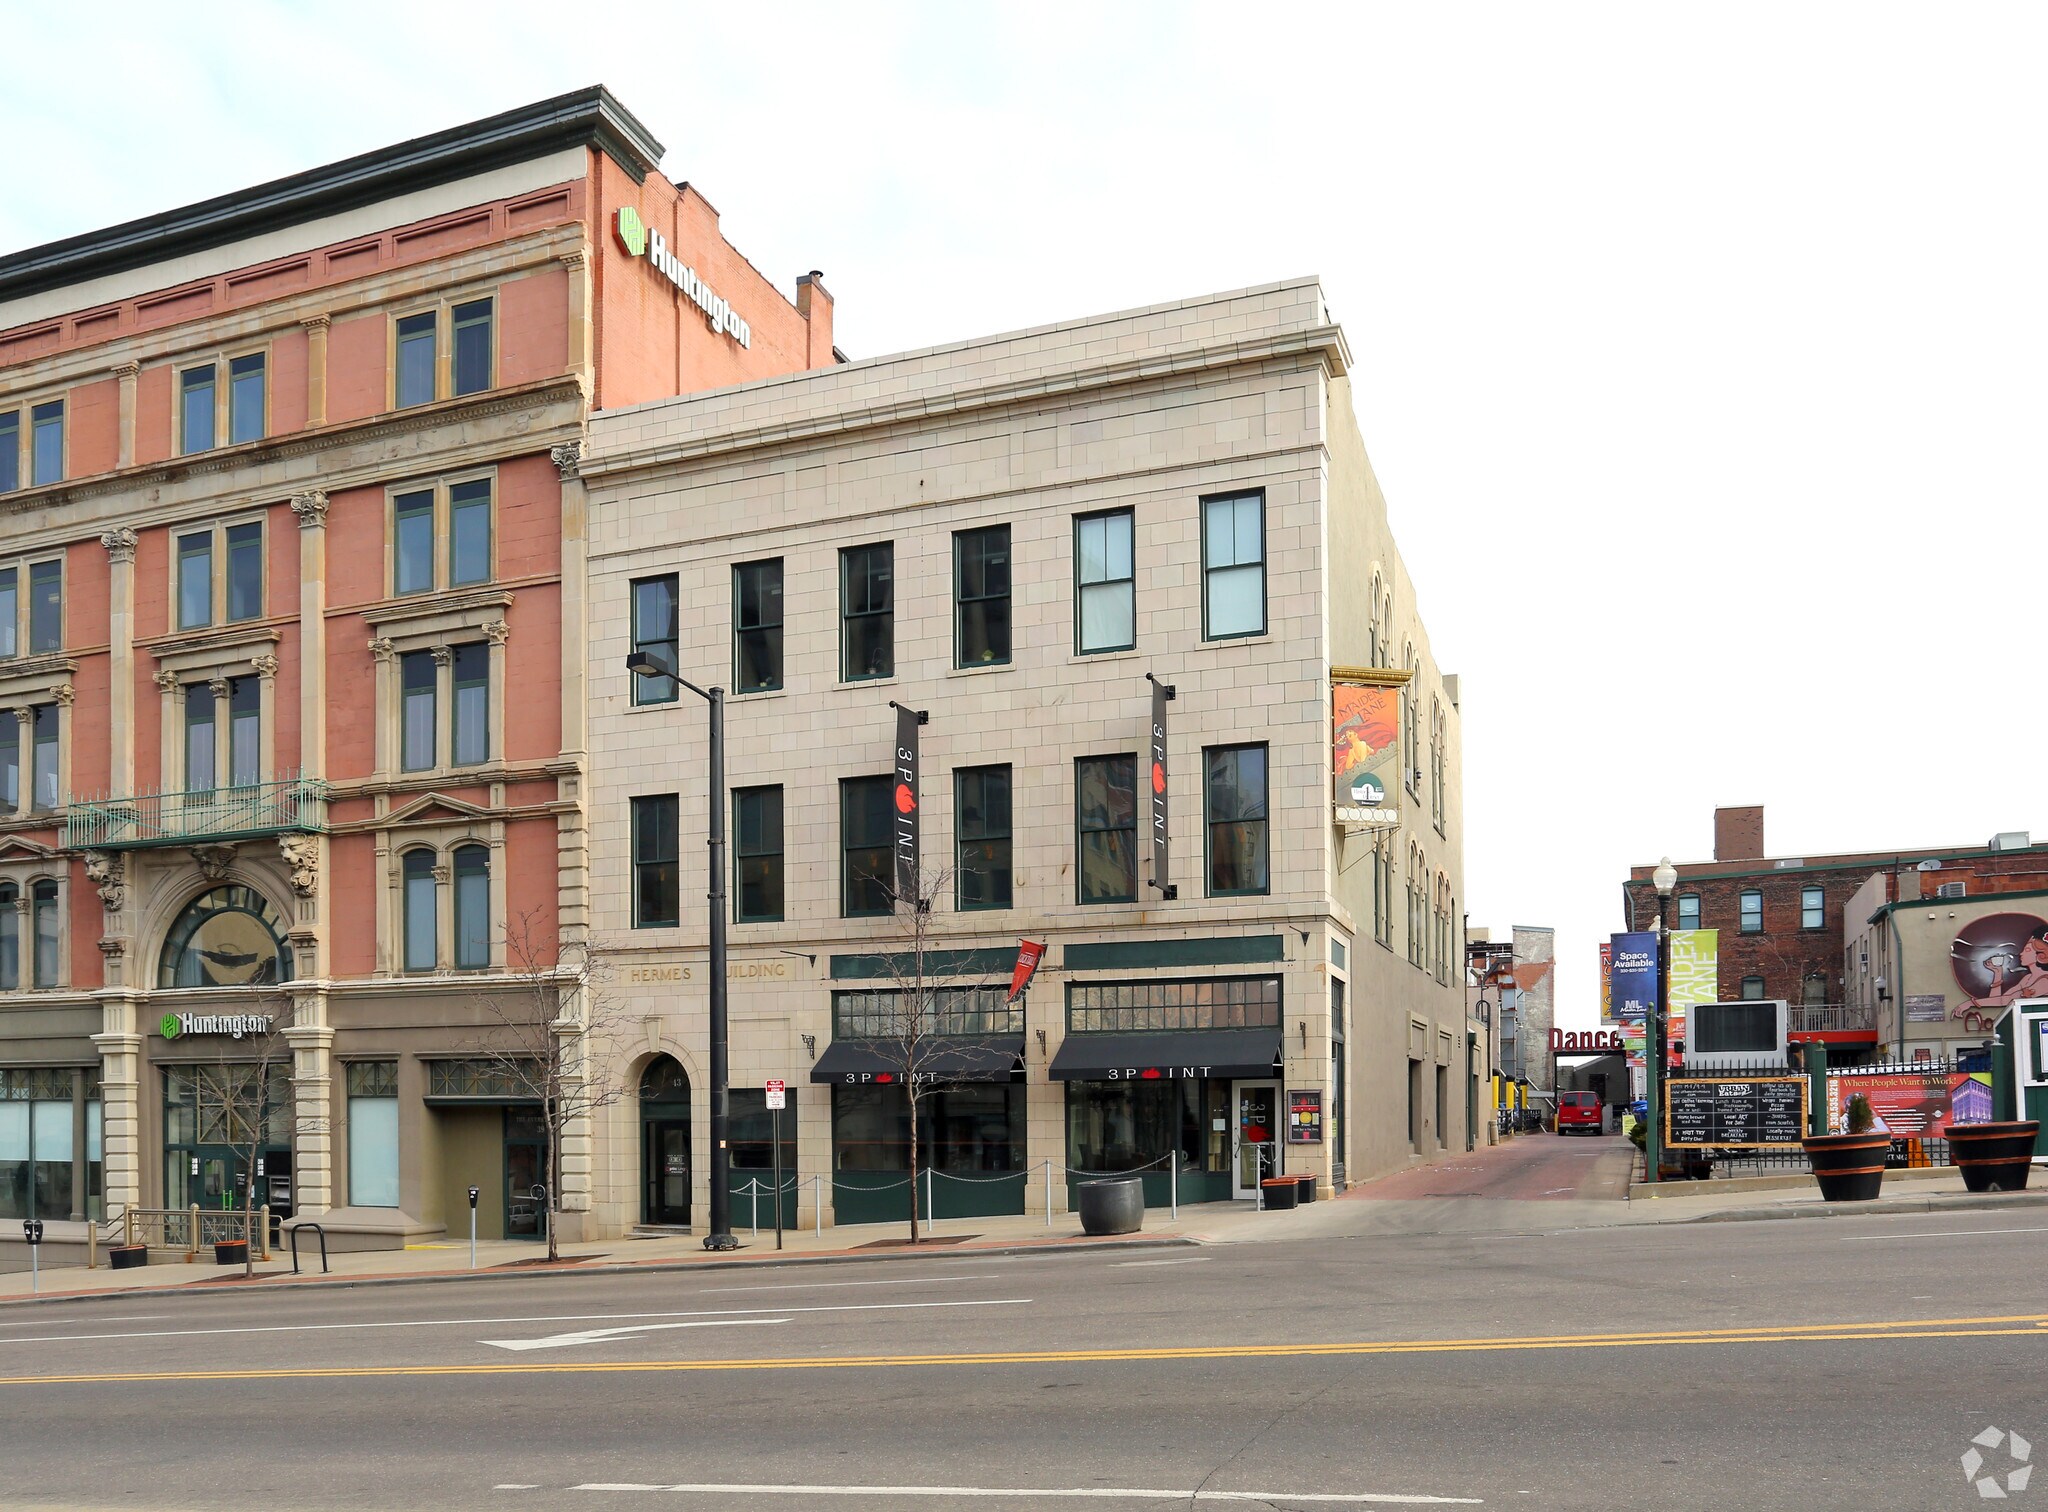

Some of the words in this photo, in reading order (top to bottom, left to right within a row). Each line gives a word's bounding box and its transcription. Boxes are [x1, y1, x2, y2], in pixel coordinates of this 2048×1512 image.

[650, 227, 750, 350] Huntington
[1338, 690, 1380, 720] MAIDEN
[1357, 697, 1387, 723] LANE
[1613, 959, 1654, 969] Available
[1619, 952, 1649, 962] Space
[631, 967, 691, 982] HERMES
[726, 963, 785, 978] UILDING
[1694, 951, 1717, 1003] ANE
[182, 1012, 267, 1039] Huntington
[1548, 1027, 1620, 1052] Dance
[1844, 1079, 1869, 1087] Where
[1871, 1078, 1898, 1088] People
[1899, 1078, 1920, 1086] Want
[1932, 1077, 1957, 1085] Work!
[1829, 1079, 1839, 1127] 330.535.3218
